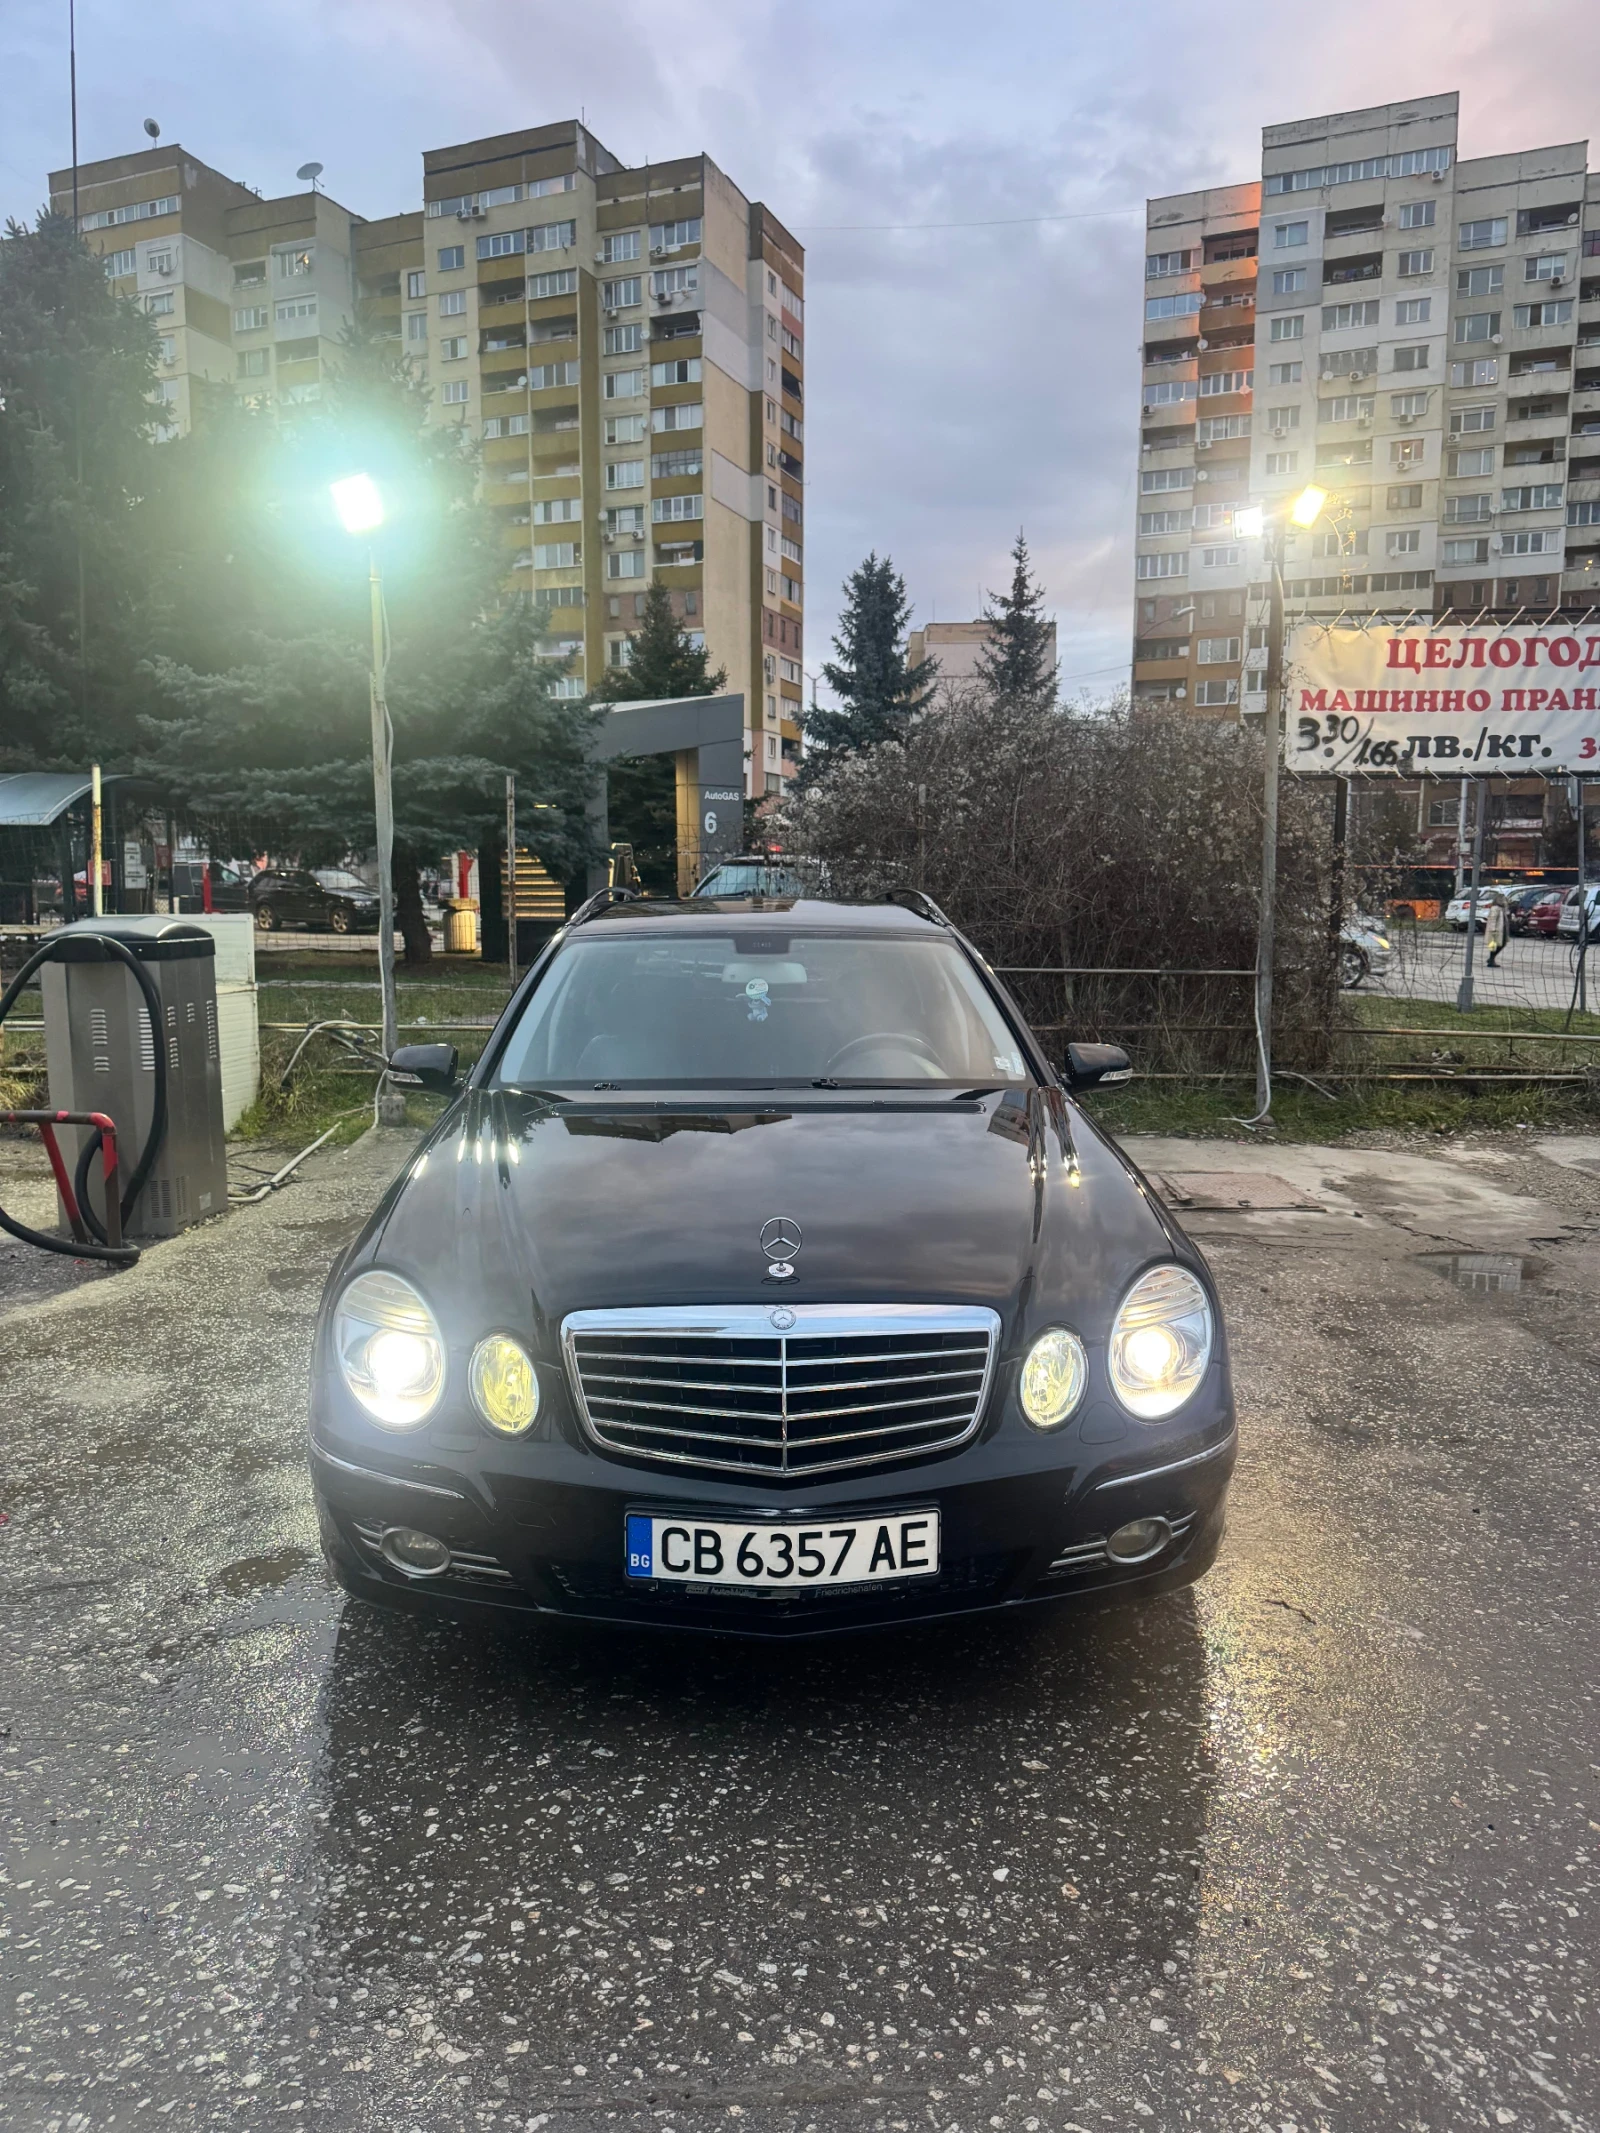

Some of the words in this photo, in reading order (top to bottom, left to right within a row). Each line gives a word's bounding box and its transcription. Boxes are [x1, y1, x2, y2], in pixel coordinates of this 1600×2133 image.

[1299, 688, 1491, 712] МАШИННО
[1501, 688, 1600, 711] ПРАН
[704, 791, 739, 801] AutoGAS
[704, 811, 717, 834] 6
[661, 1527, 724, 1576] CB
[736, 1529, 856, 1578] 6357
[869, 1521, 929, 1572] AE
[630, 1553, 650, 1568] BG
[814, 1583, 883, 1599] Friedrichshafen
